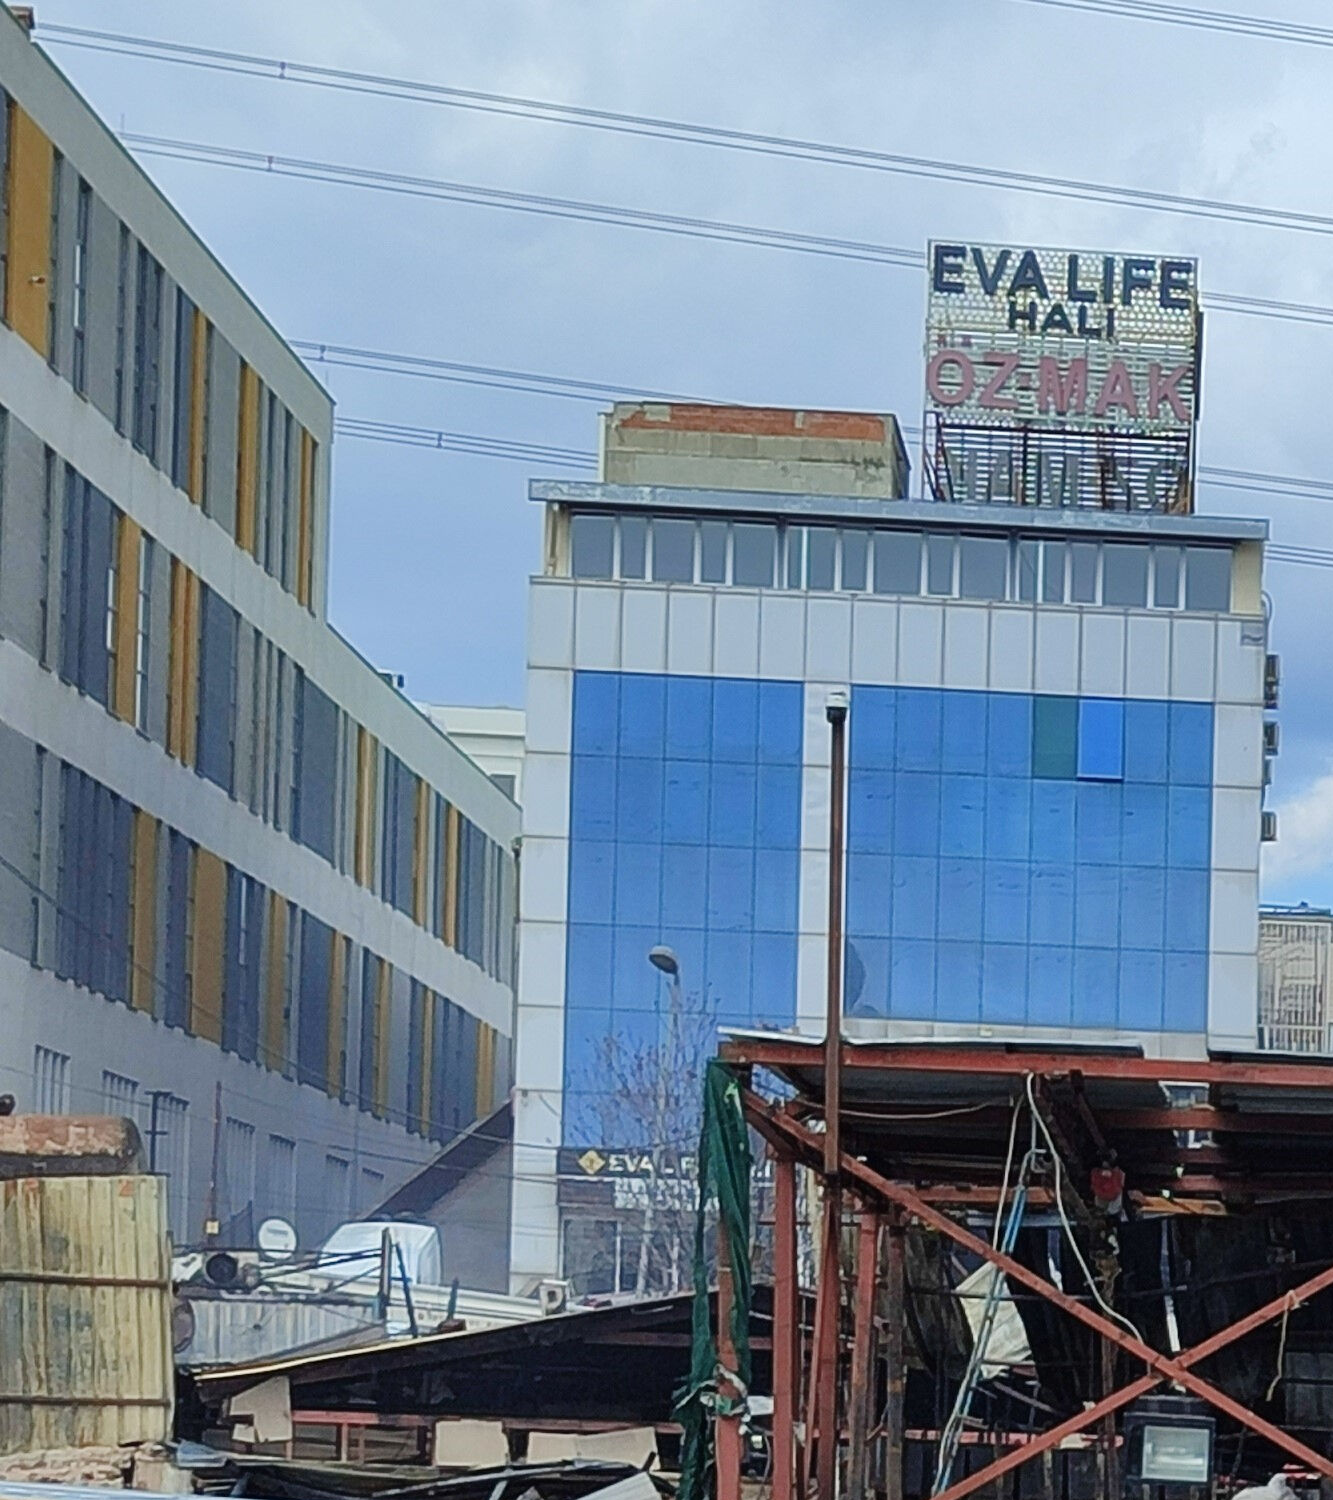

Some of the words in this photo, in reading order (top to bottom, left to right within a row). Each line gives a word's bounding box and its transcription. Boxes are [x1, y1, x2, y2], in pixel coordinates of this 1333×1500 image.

[933, 244, 1050, 299] EVA
[1067, 254, 1193, 310] LIFE
[1008, 300, 1115, 338] HALI
[608, 1153, 653, 1173] EVA
